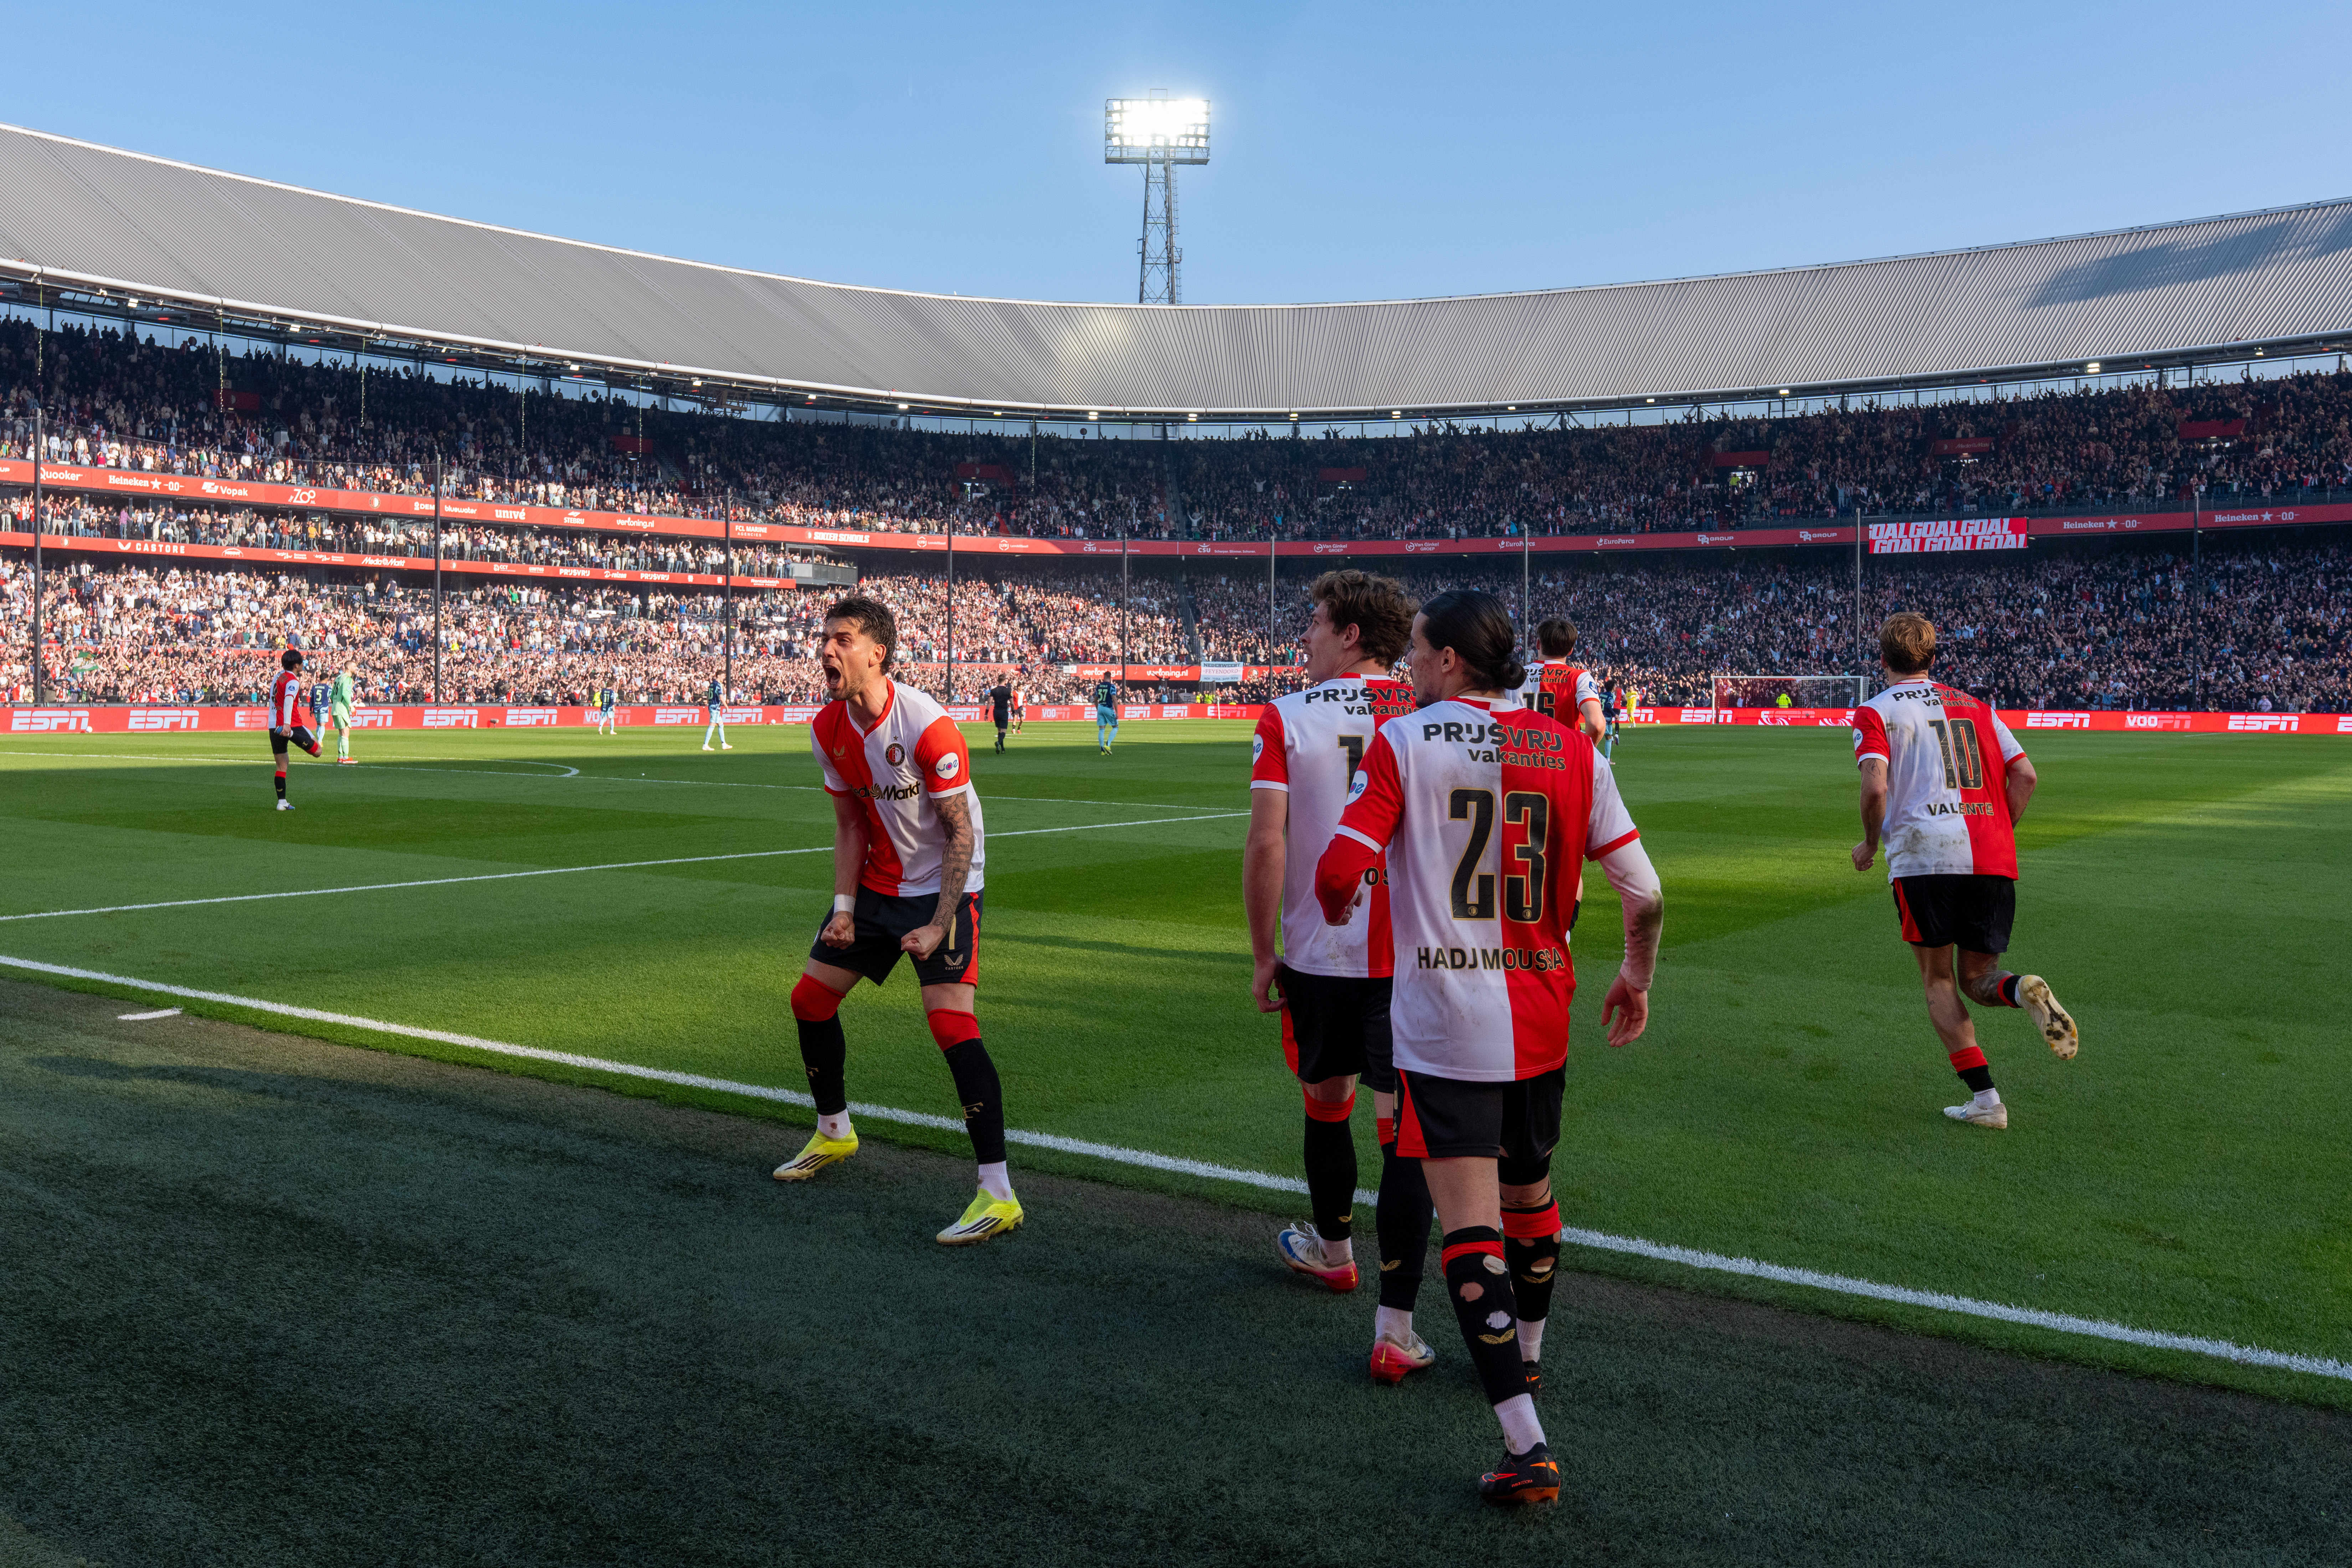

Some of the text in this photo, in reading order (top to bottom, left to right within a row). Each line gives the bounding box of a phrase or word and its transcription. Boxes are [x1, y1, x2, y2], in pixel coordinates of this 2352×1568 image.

[109, 475, 149, 487] Heineken
[220, 485, 248, 497] Vopak
[445, 505, 477, 514] bluewater
[495, 508, 525, 520] univé
[617, 517, 654, 529] verloning.nl
[2215, 513, 2259, 523] Heineken
[2063, 521, 2105, 529] Heineken
[135, 543, 185, 554] CASTORE
[604, 570, 627, 579] D-reizen
[316, 689, 322, 702] 5
[1098, 689, 1108, 701] 37
[1523, 692, 1555, 719] 16
[1922, 697, 1978, 709] vakanties
[423, 709, 478, 726] ESPN
[506, 709, 558, 726] ESPN
[655, 709, 699, 724] ESPN
[722, 708, 762, 723] ESPN
[948, 708, 980, 720] ESPN
[1124, 706, 1150, 718] ESPN
[1163, 706, 1188, 717] ESPN
[1680, 709, 1733, 723] ESPN
[11, 710, 89, 730] ESPN
[128, 710, 199, 729] ESPN
[2027, 713, 2090, 727] ESPN
[2228, 715, 2299, 731] ESPN
[1468, 747, 1566, 771] vakanties
[1927, 718, 1983, 790] 10
[883, 781, 920, 801] Markt
[1926, 802, 1994, 816] VALENTE
[1449, 787, 1549, 924] 23
